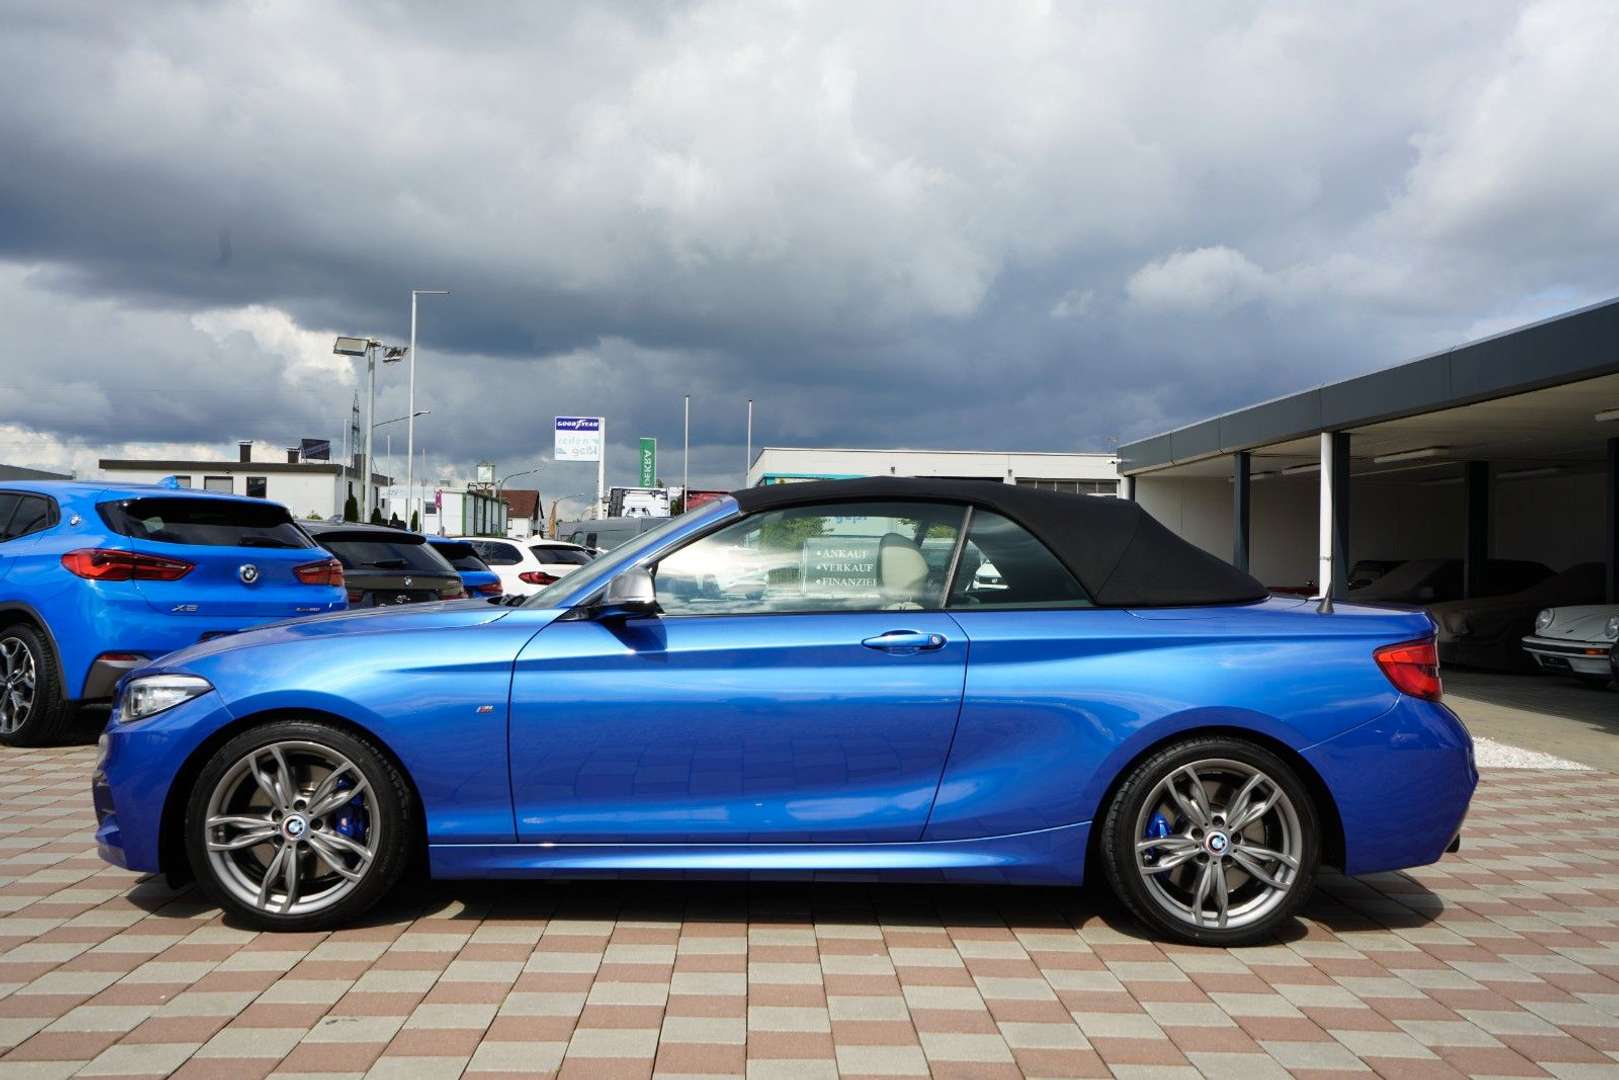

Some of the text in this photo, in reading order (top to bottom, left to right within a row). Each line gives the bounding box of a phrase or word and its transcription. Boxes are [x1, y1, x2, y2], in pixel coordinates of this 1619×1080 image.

[557, 420, 598, 428] GOODYEAR
[822, 549, 866, 558] ANKAUF
[822, 563, 873, 572] VERKAUF
